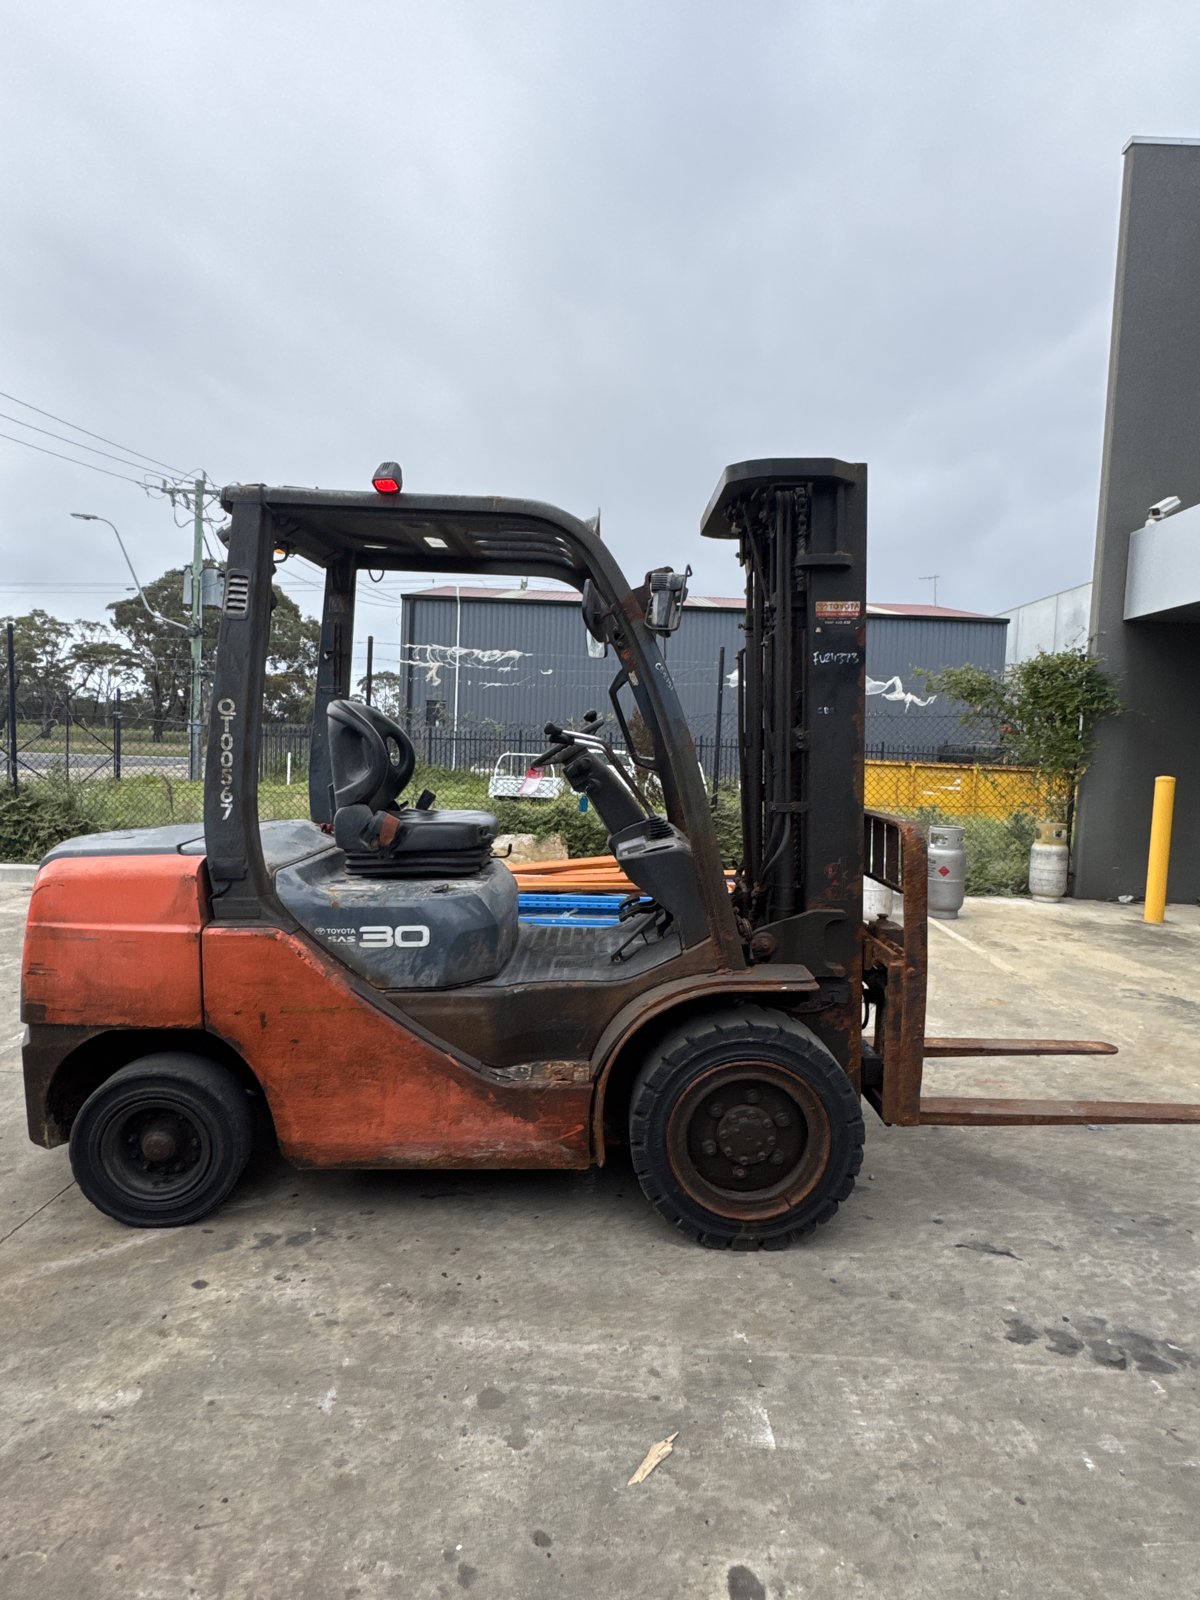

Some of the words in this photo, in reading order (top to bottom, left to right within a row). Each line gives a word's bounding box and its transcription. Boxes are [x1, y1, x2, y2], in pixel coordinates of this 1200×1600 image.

[829, 602, 860, 610] TOYOTA
[217, 697, 237, 820] QT00567
[328, 935, 356, 943] SAS
[359, 925, 430, 947] 30
